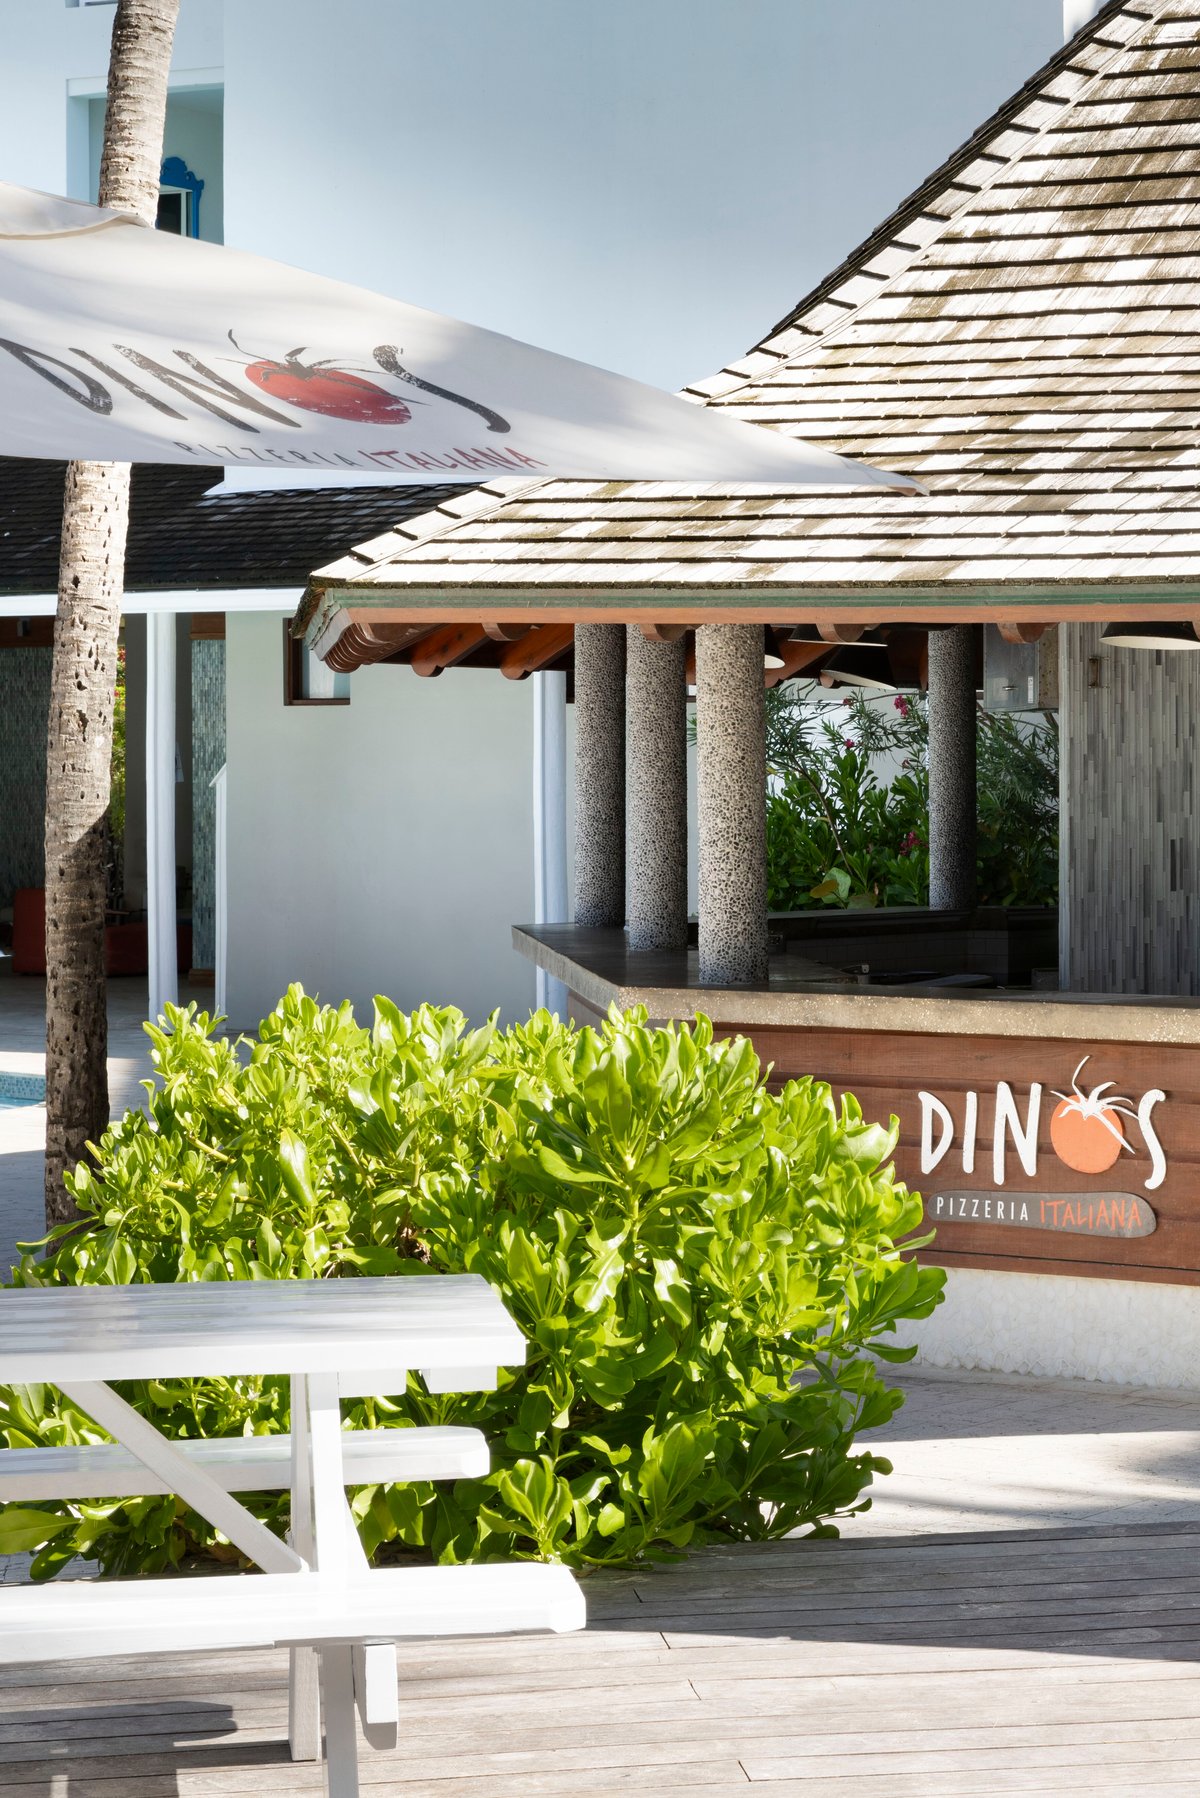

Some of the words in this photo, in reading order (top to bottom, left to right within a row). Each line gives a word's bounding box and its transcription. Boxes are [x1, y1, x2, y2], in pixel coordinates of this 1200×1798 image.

[173, 441, 363, 467] PIZZERIA
[358, 447, 548, 470] ITALIANA
[936, 1196, 1029, 1221] PIZZERIA
[1039, 1199, 1143, 1232] ITALIANA
